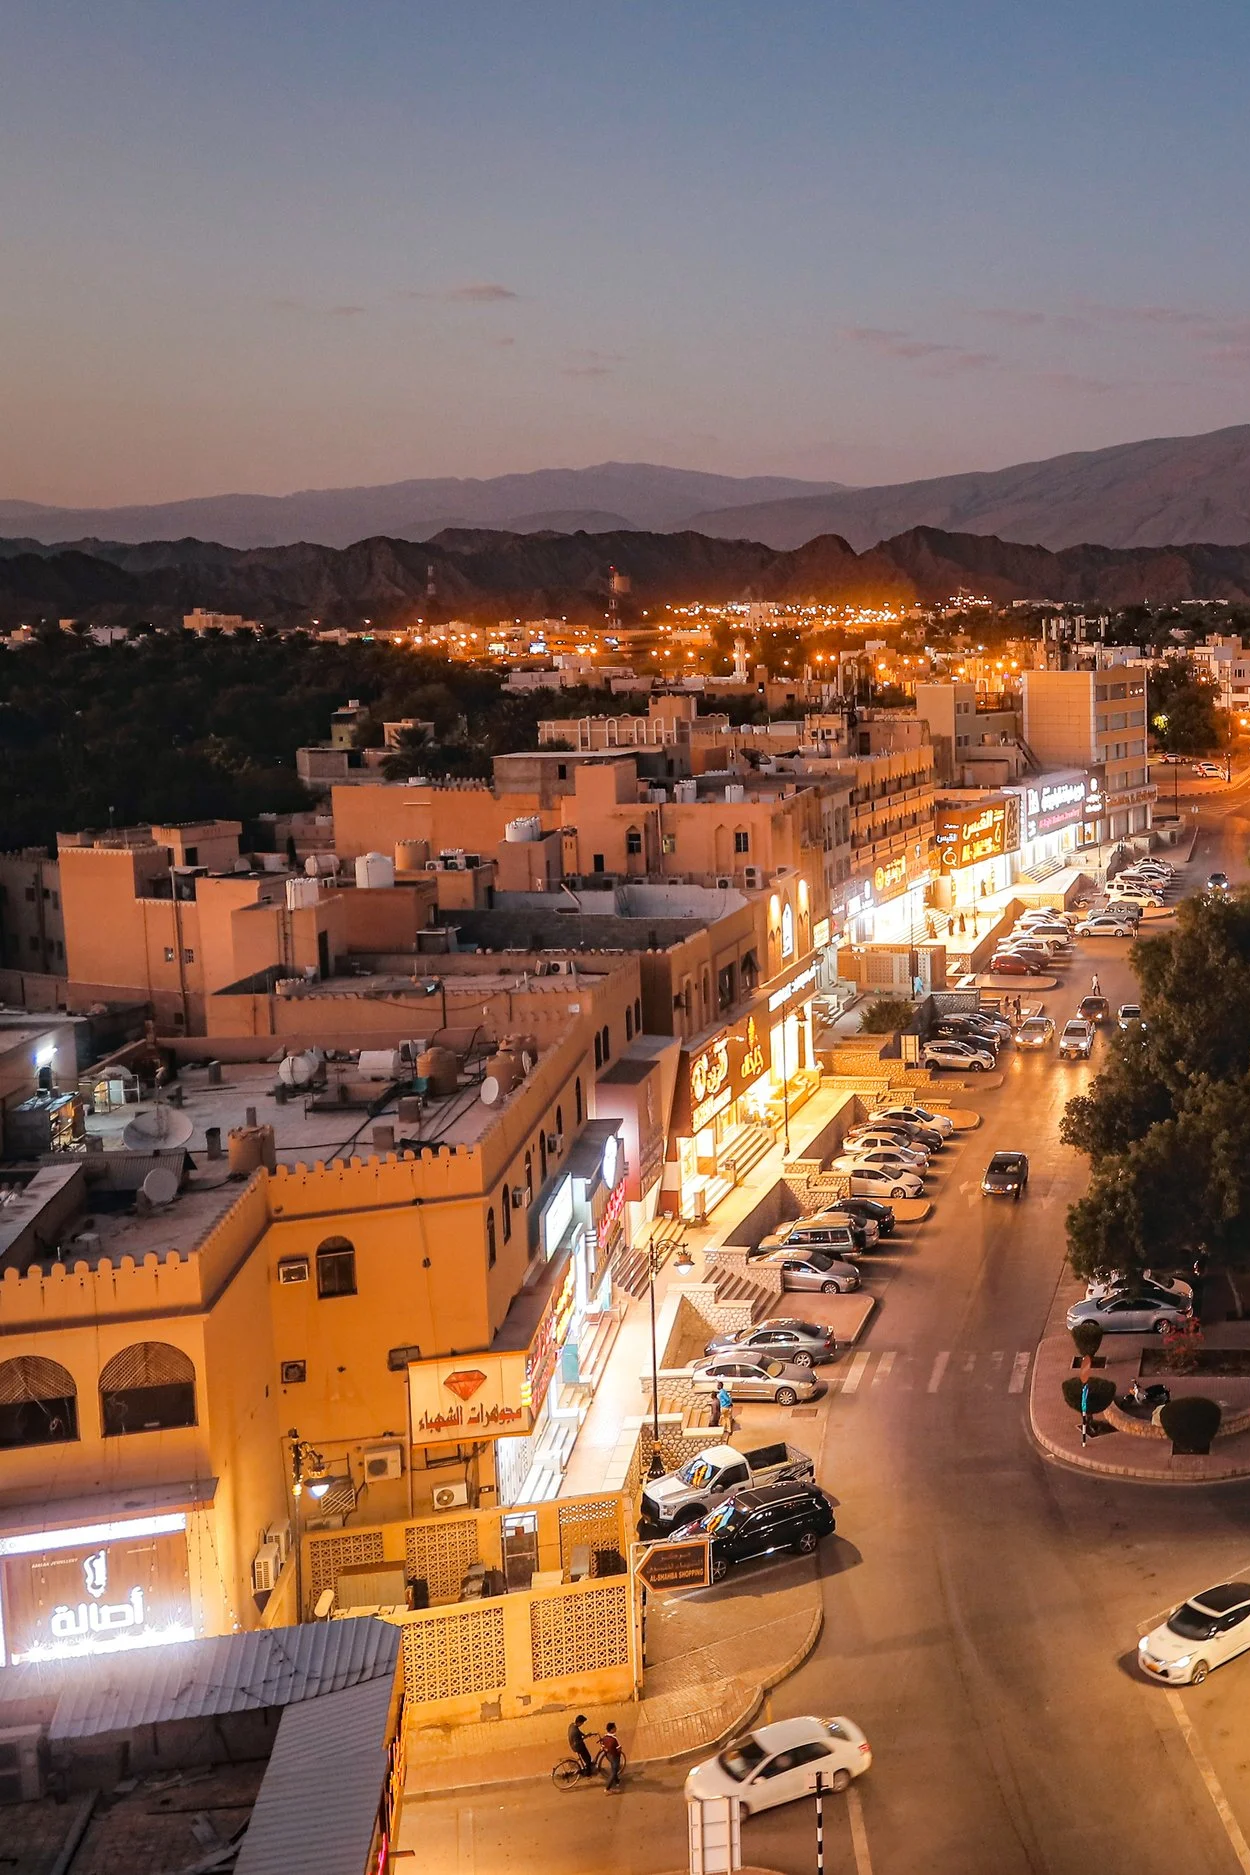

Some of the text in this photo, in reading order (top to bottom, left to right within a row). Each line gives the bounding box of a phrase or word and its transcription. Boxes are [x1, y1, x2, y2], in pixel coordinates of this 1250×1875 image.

[962, 809, 994, 841] القبس
[419, 1403, 522, 1433] مجوهرات الشهباء
[678, 1568, 704, 1579] SHOPPING
[51, 1586, 144, 1637] أصالة
